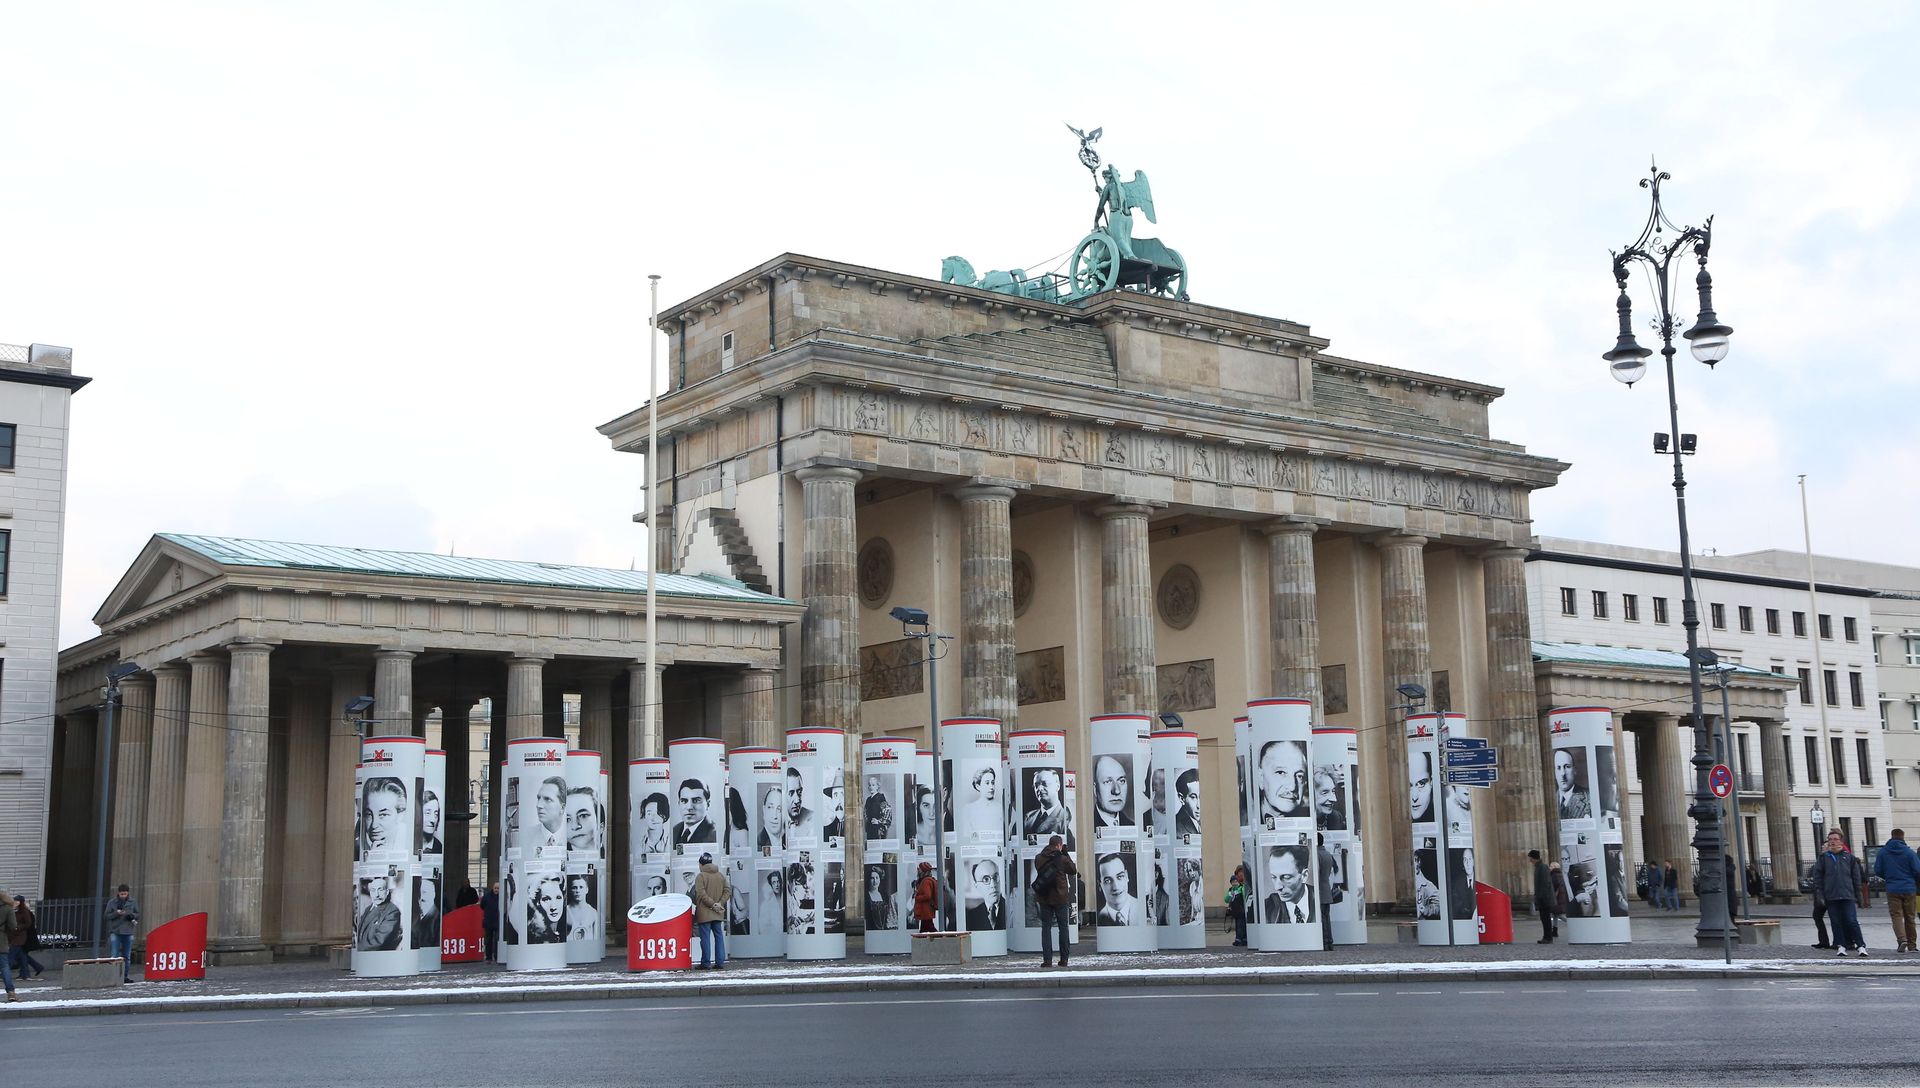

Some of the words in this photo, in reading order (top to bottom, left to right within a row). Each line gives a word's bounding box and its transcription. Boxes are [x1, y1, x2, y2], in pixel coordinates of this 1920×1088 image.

[441, 938, 466, 954] 938
[639, 938, 677, 960] 1933
[152, 952, 187, 971] 1938
